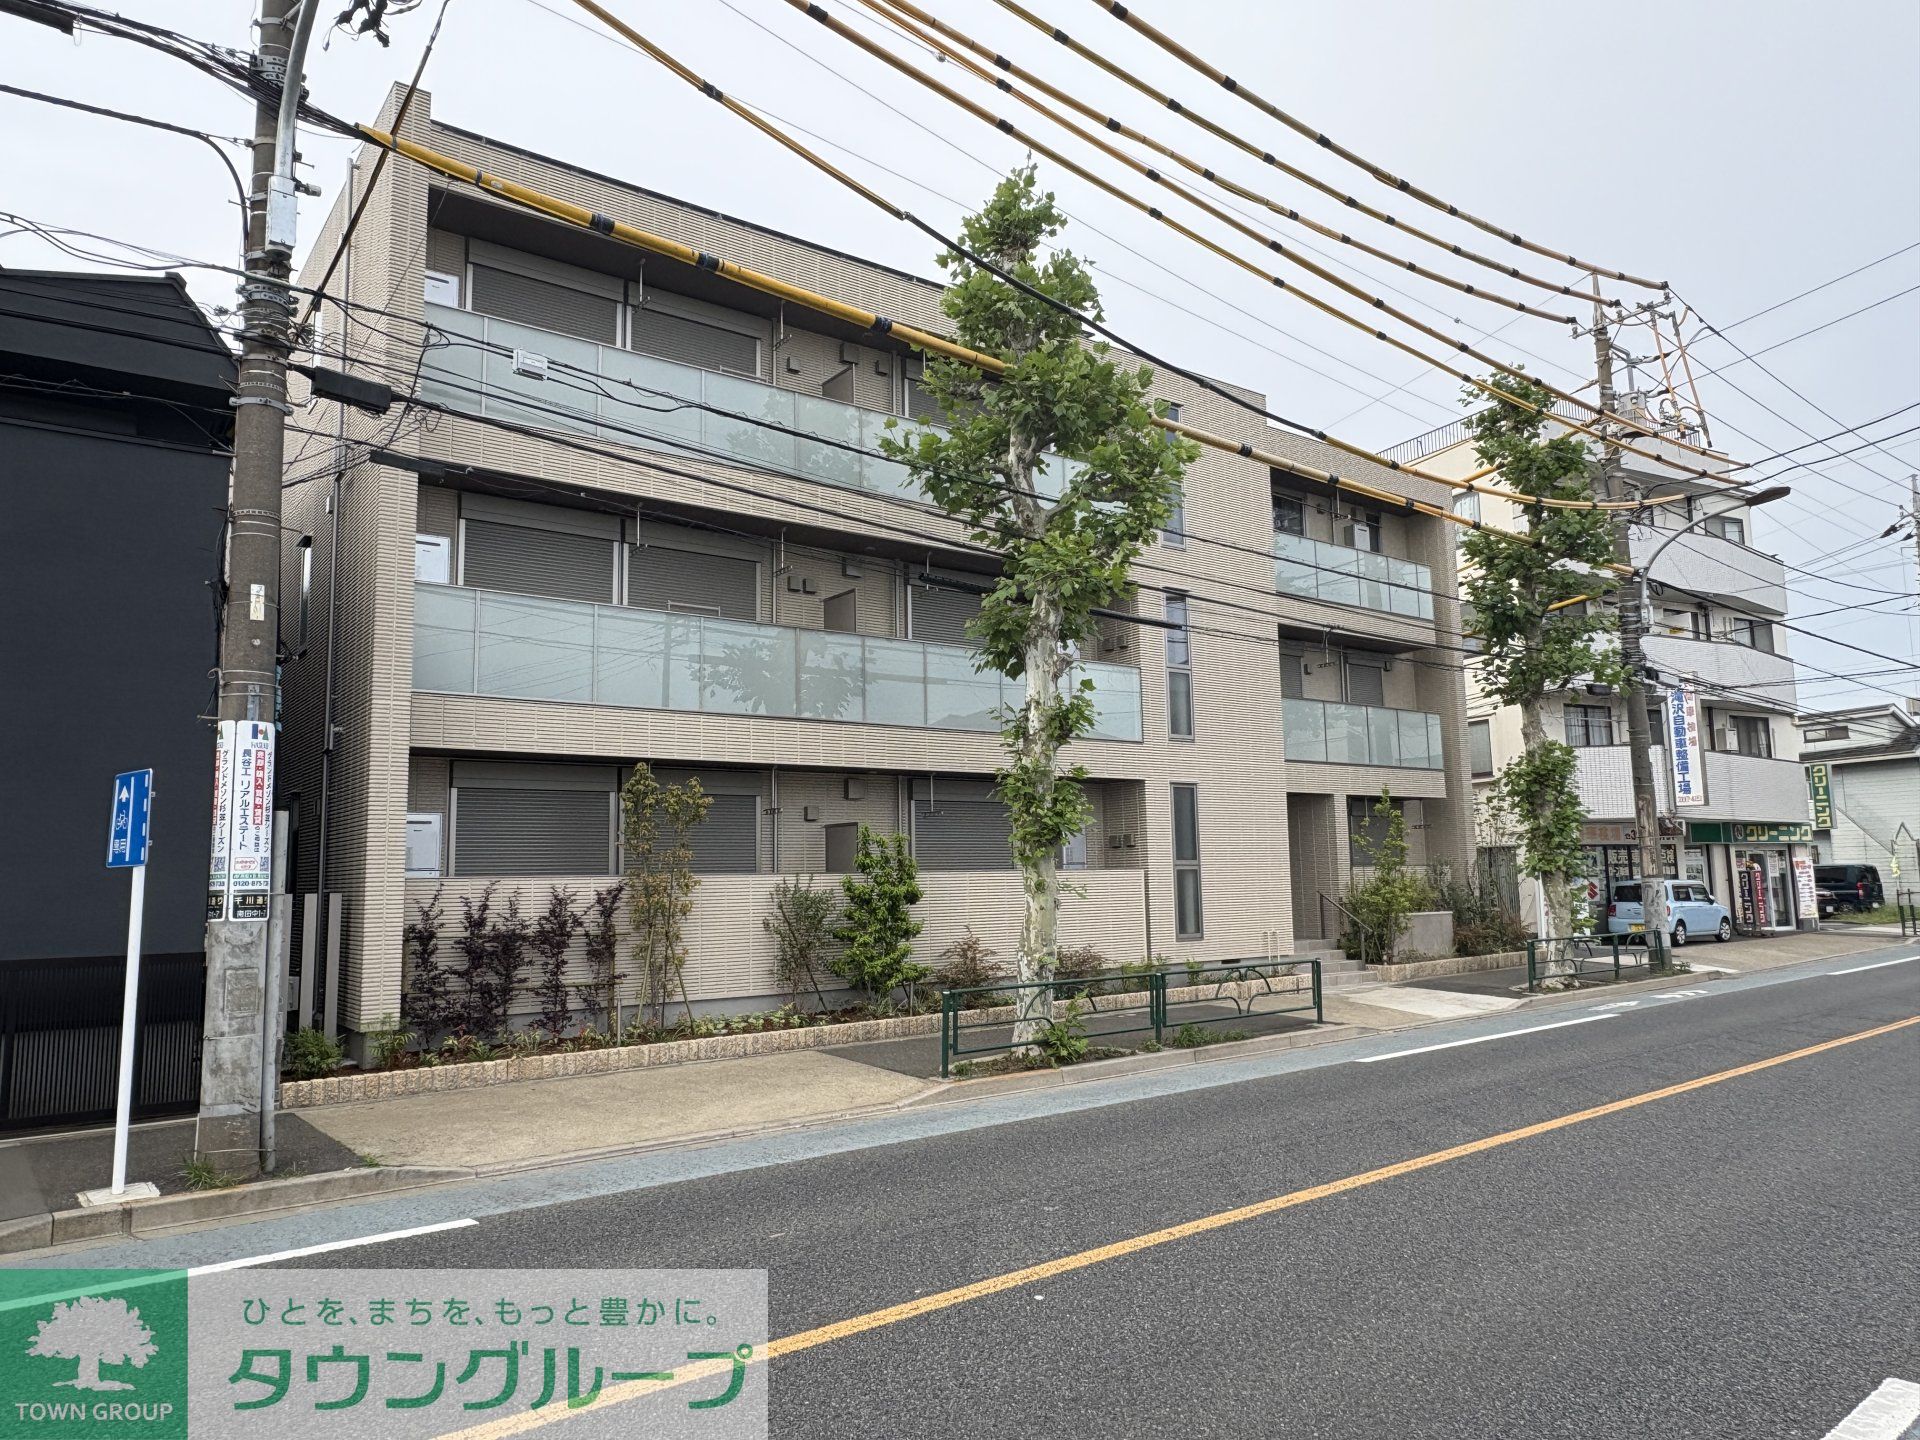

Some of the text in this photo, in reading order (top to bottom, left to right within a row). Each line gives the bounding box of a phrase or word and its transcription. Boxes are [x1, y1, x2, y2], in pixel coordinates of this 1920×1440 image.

[1813, 765, 1831, 828] クリーニング
[1746, 825, 1812, 842] クリーニング
[1741, 873, 1754, 923] クリーニング
[1755, 873, 1766, 922] クリーニング
